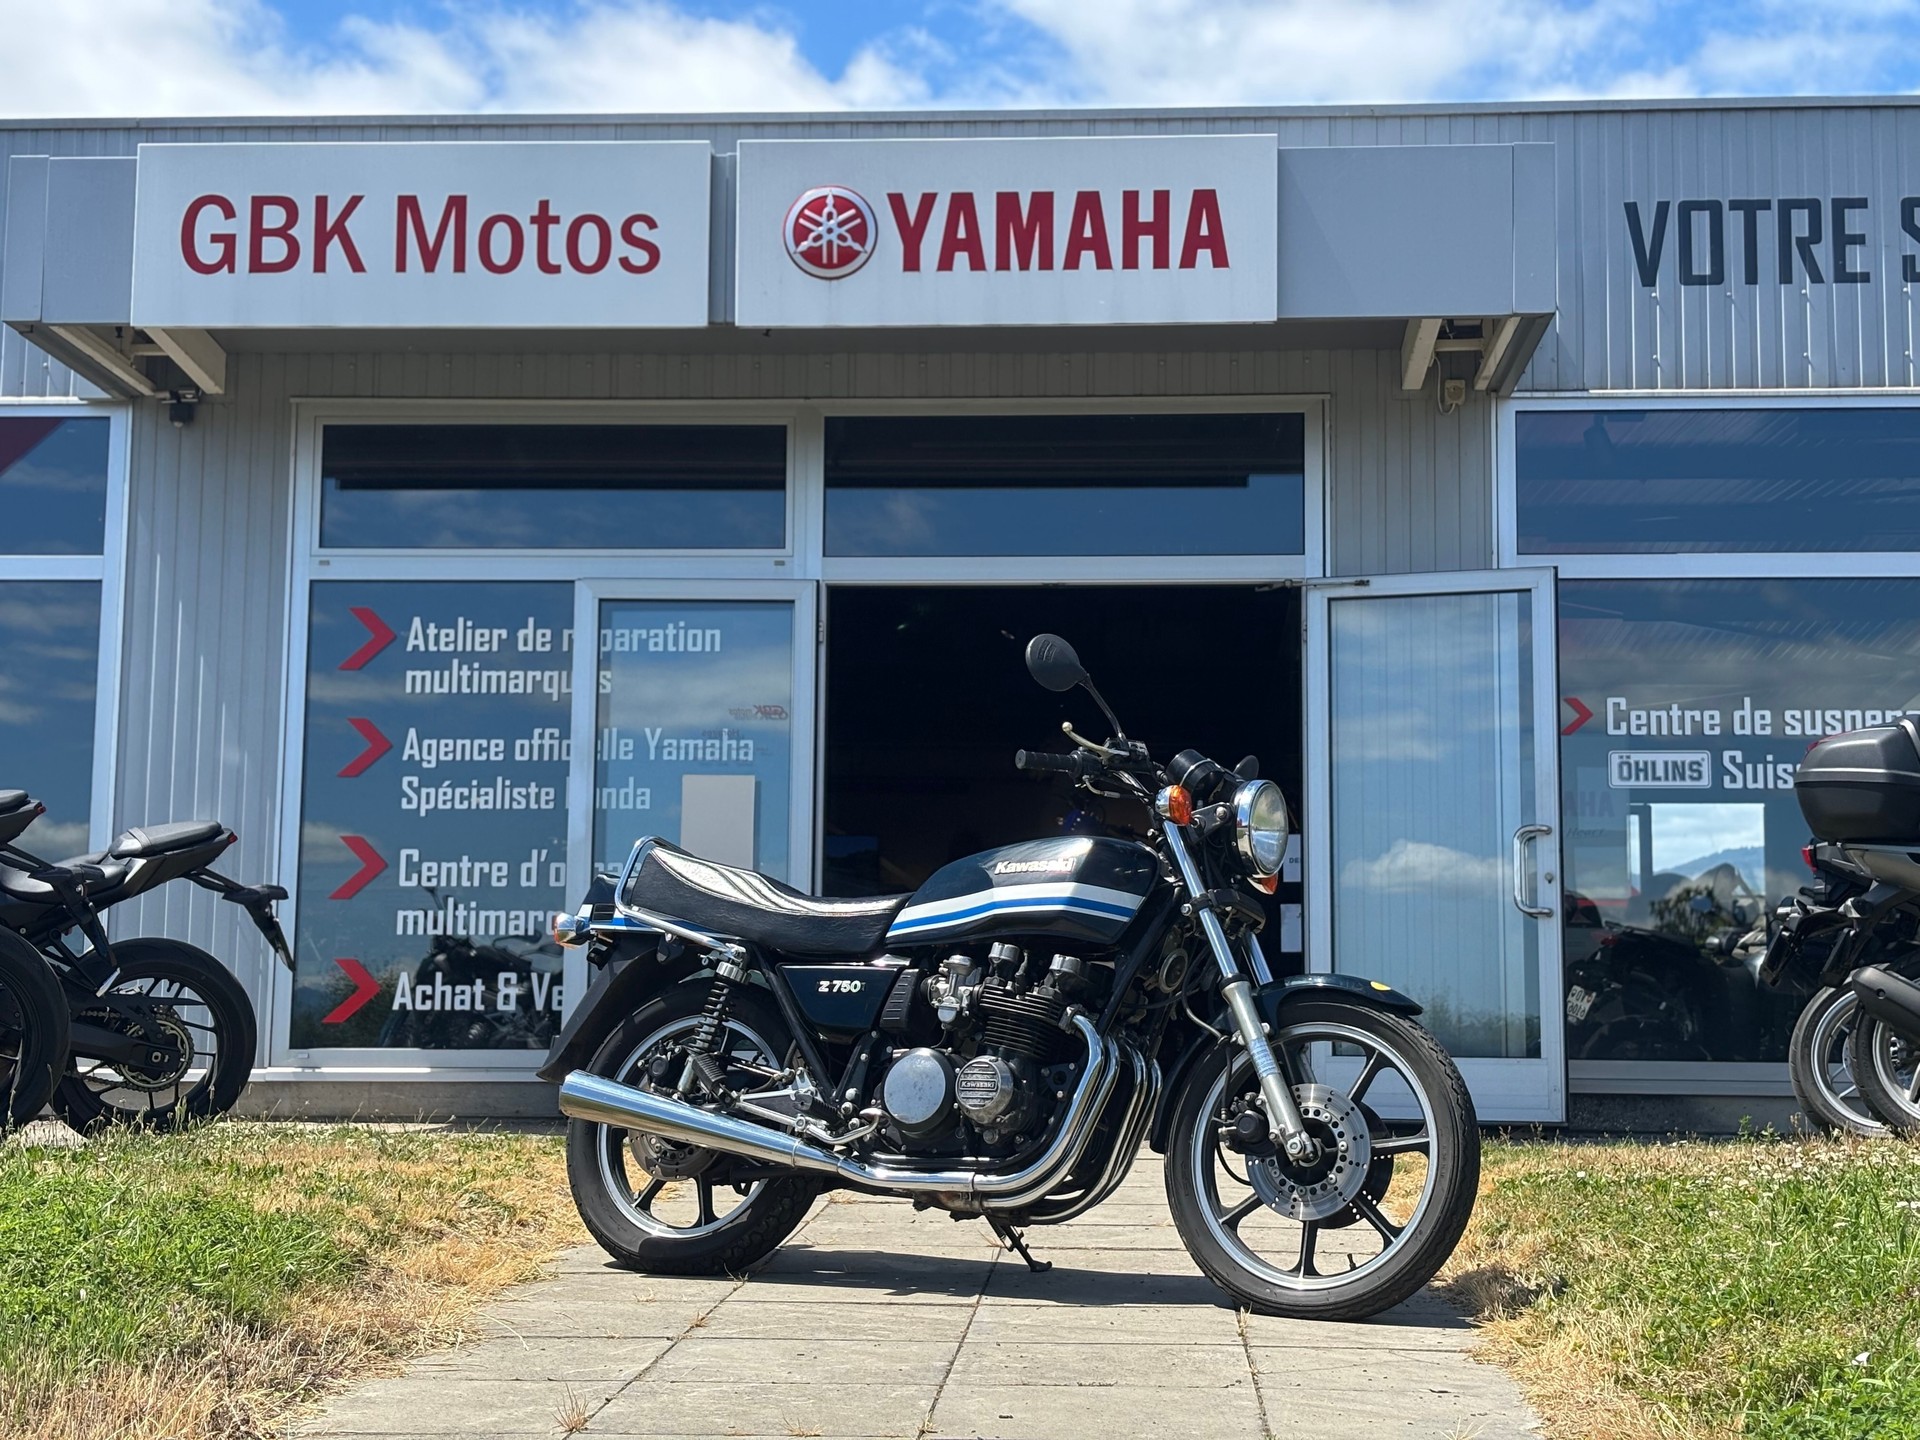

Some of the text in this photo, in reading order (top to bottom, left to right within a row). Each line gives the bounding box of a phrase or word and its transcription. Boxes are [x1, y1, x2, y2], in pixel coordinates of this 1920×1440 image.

[180, 193, 661, 275] GBK Motos
[886, 188, 1230, 273] YAMAHA
[1623, 197, 1871, 287] VOTRE
[405, 616, 721, 659] Atelier de rparation
[405, 658, 612, 702] multimarqus
[1606, 697, 1721, 736] Centre
[1733, 697, 1772, 736] de
[402, 727, 505, 768] Agence
[644, 727, 754, 761] Yamaha
[1617, 750, 1801, 789] ÖHLINS Suis
[401, 775, 555, 817] Spécialiste
[399, 848, 508, 888] Centre
[994, 858, 1076, 876] Kawasaki
[392, 971, 486, 1011] Achat
[496, 971, 518, 1011] &
[818, 980, 861, 993] Z 750
